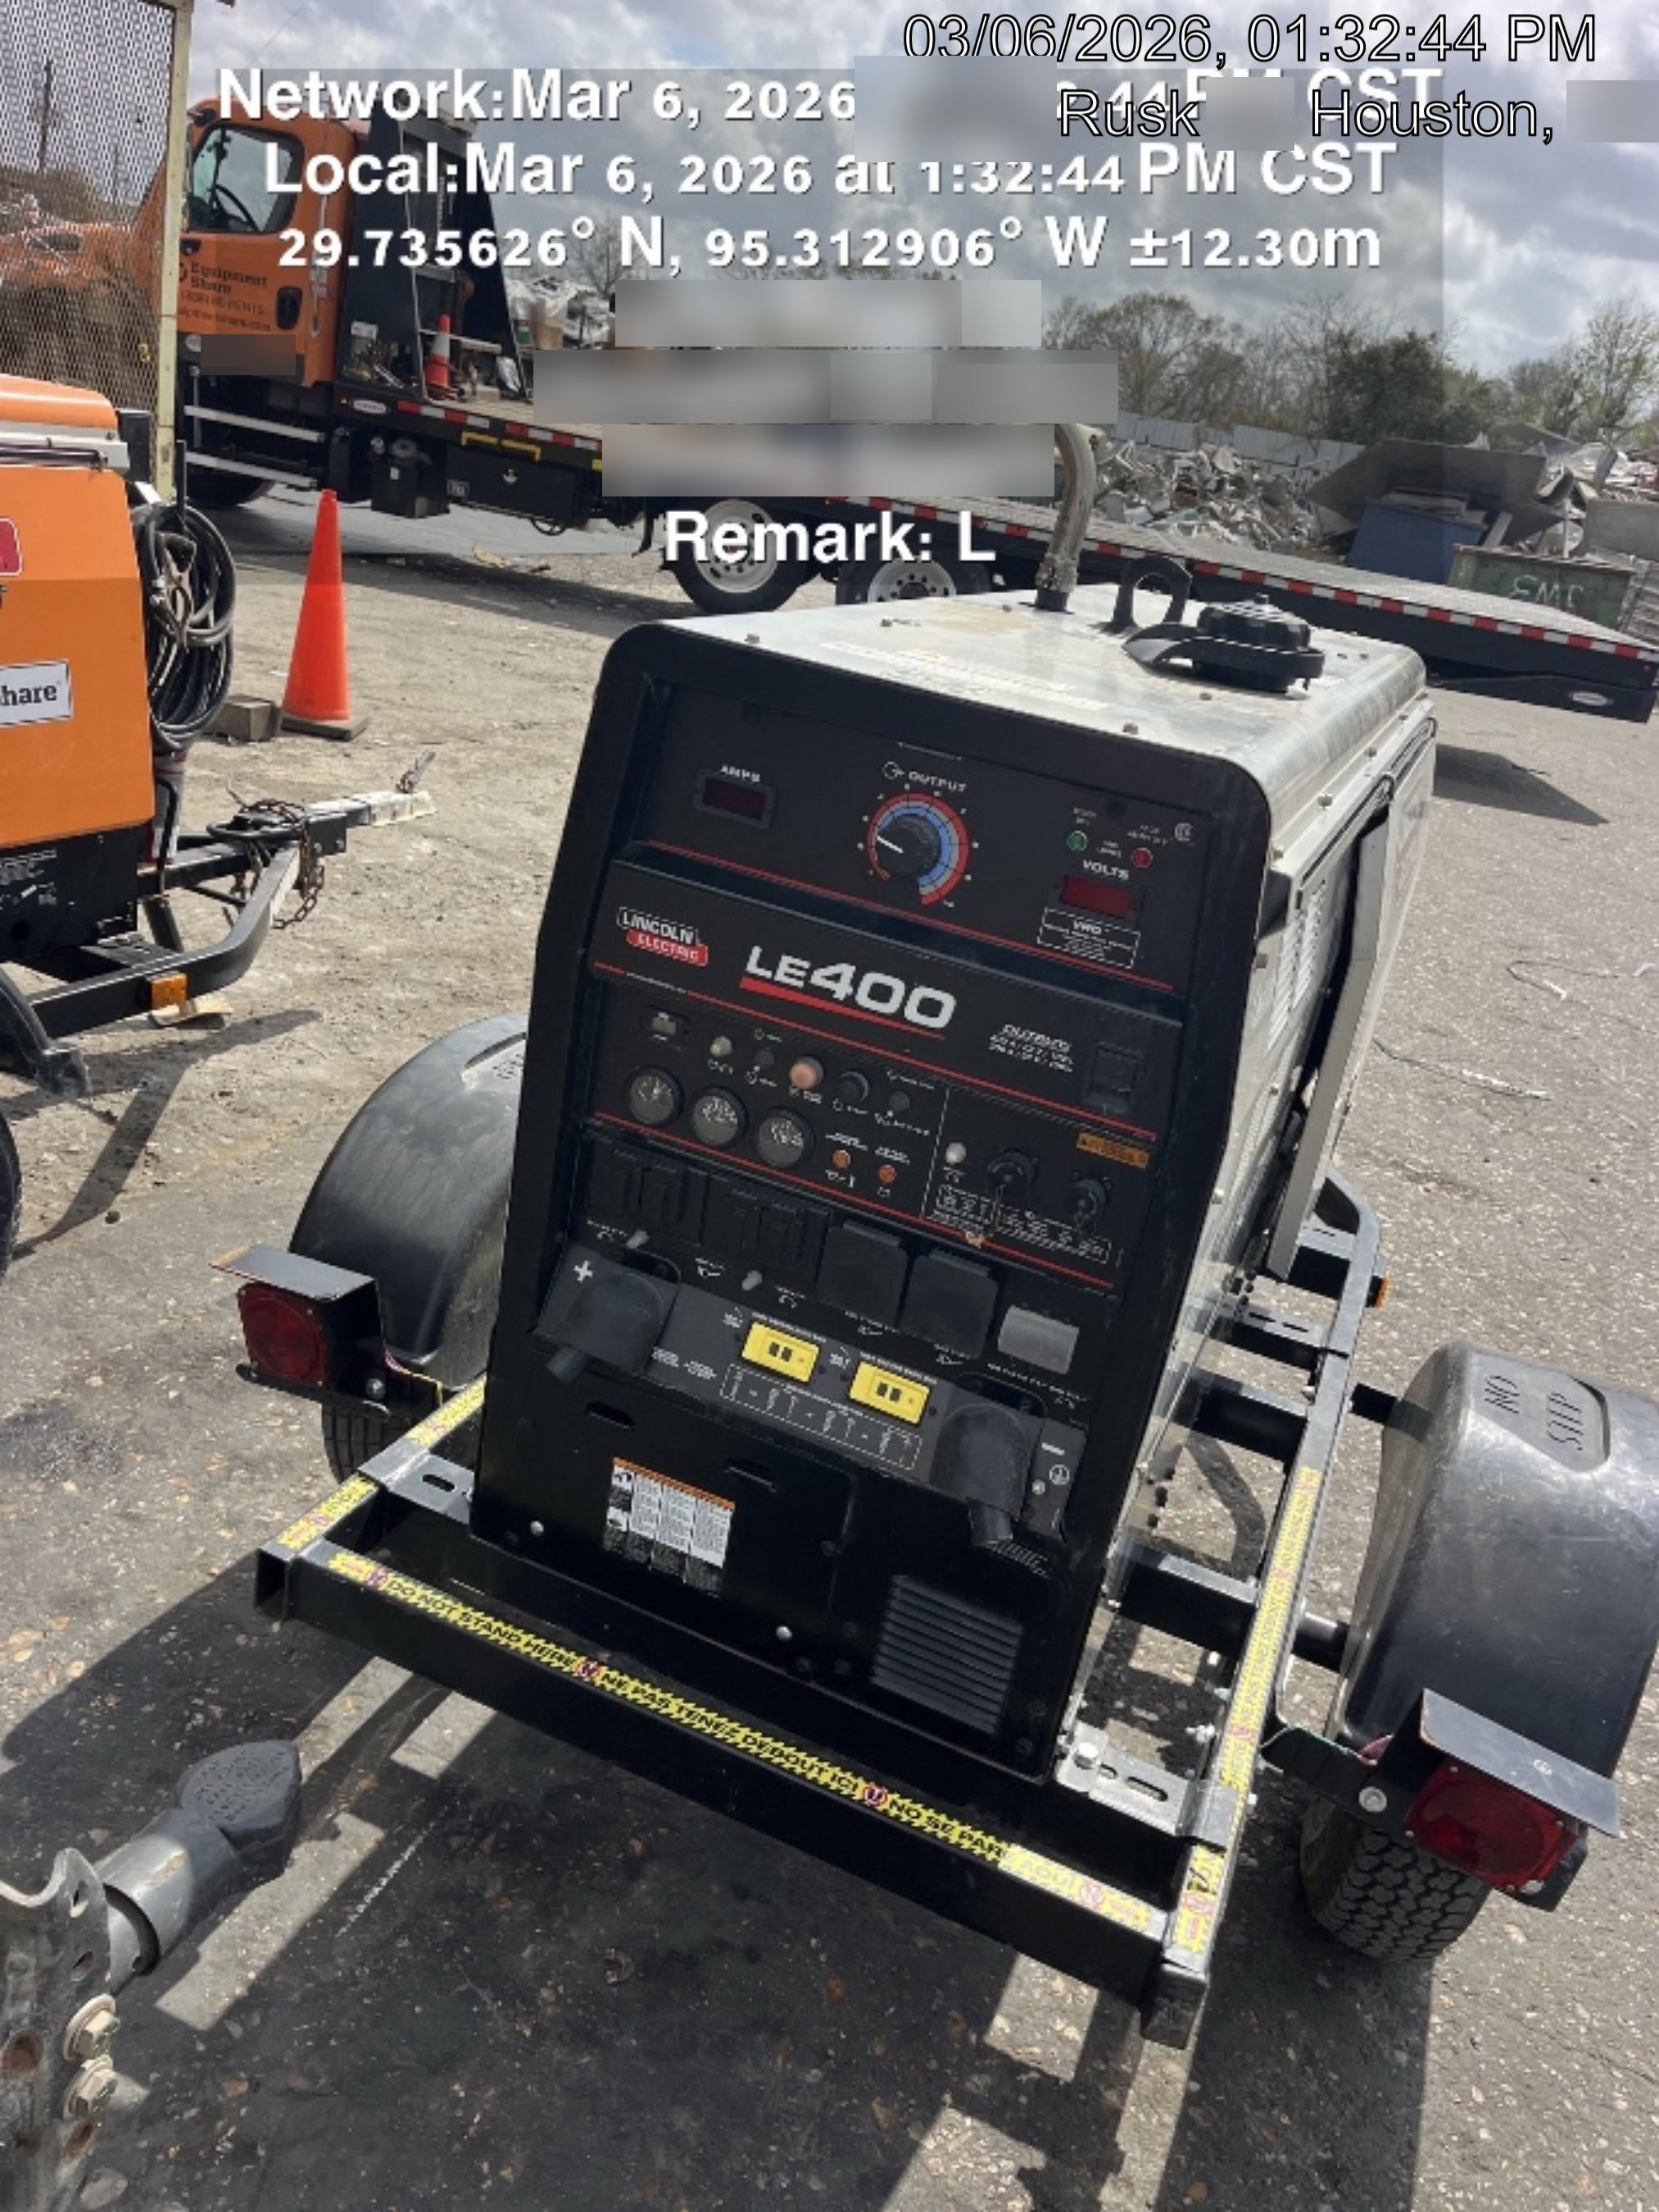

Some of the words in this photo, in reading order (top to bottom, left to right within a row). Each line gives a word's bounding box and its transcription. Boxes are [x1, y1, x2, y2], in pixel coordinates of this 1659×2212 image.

[909, 771, 968, 793] OUTPUT
[1083, 859, 1130, 881] VOLTS
[623, 911, 695, 944] LINCOLN
[746, 945, 956, 1029] LE400
